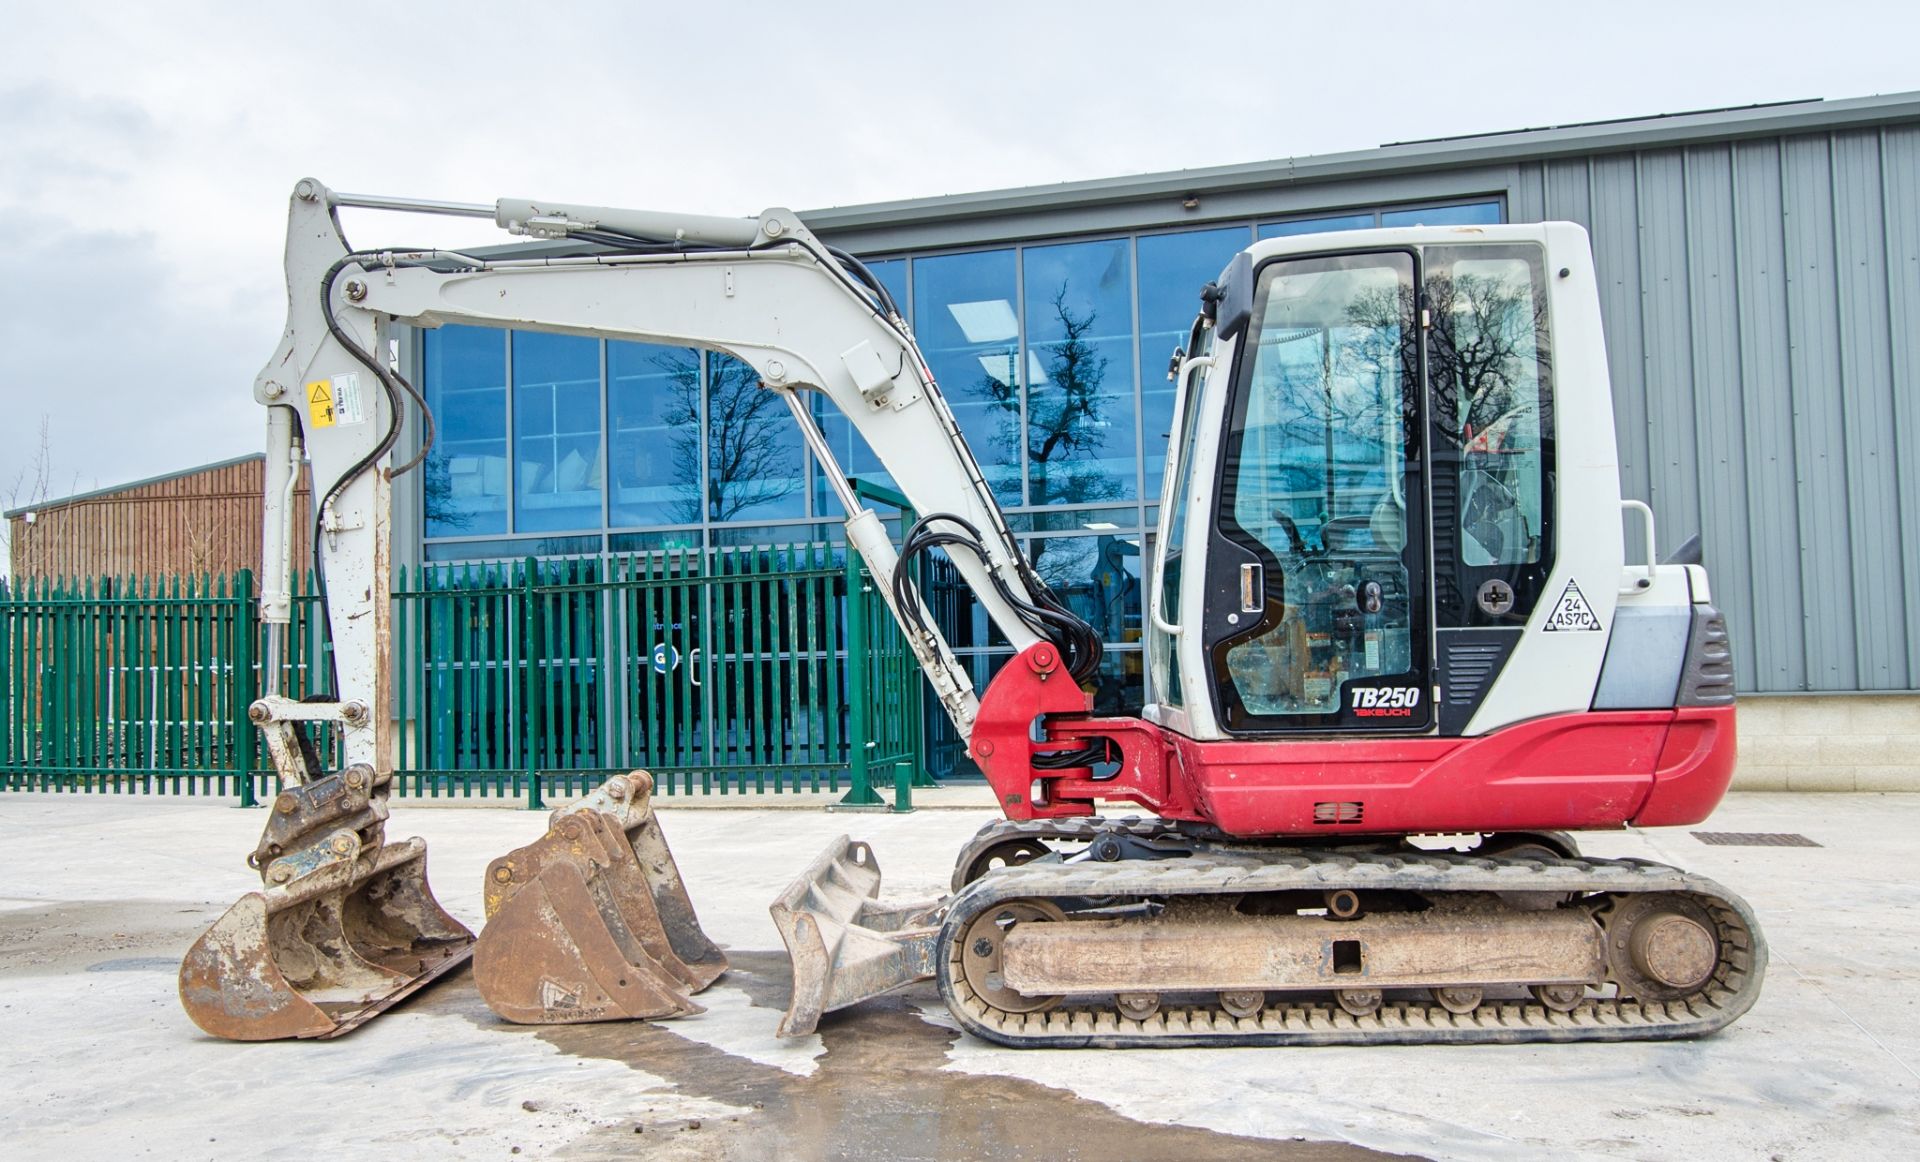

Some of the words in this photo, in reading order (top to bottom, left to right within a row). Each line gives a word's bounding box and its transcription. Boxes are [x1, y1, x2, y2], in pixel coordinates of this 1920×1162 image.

[1565, 598, 1580, 611] 24
[1557, 613, 1590, 625] AS7C
[1351, 687, 1420, 708] TB250
[1353, 708, 1411, 717] TAKEUCHI
